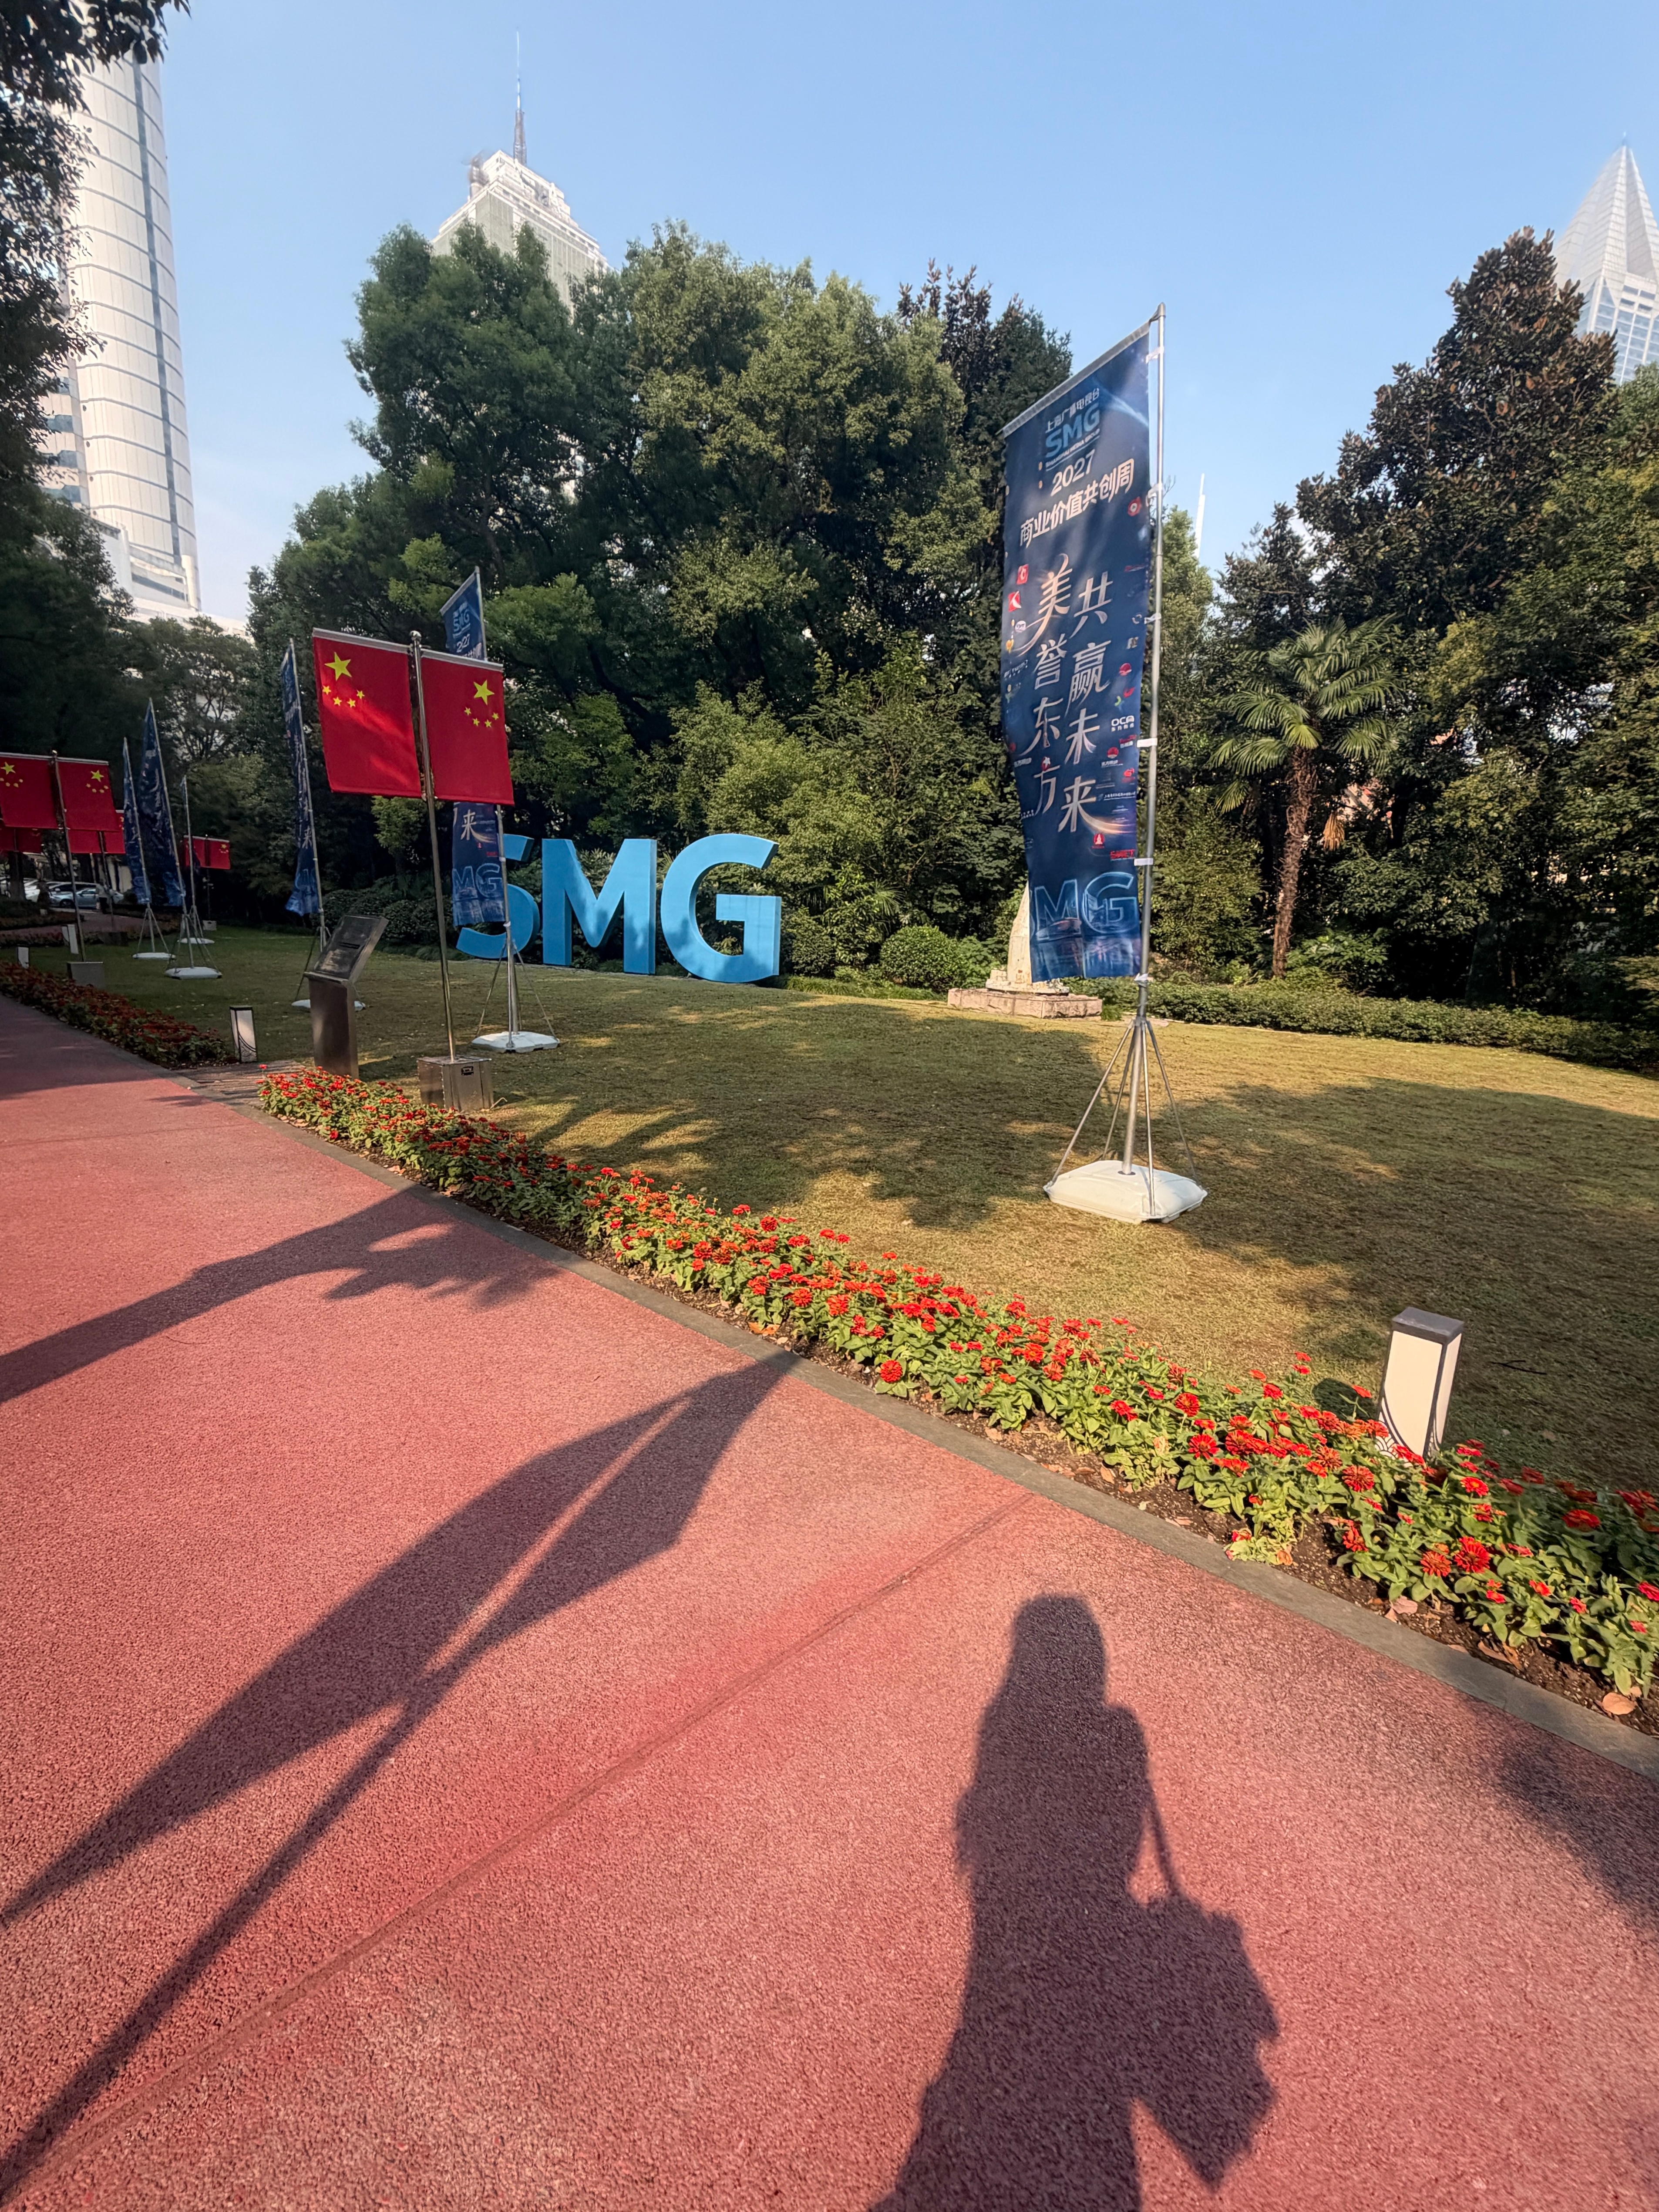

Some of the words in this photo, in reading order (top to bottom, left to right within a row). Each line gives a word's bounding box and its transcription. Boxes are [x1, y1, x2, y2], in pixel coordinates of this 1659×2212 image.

[1046, 403, 1100, 458] SMG
[1050, 449, 1095, 496] 2027
[1020, 458, 1134, 549] 商业价值共创周
[1016, 553, 1073, 817] 美誉东方
[1058, 571, 1132, 832] 共赢未来
[456, 833, 782, 983] SMG
[1029, 872, 1137, 941] MG
